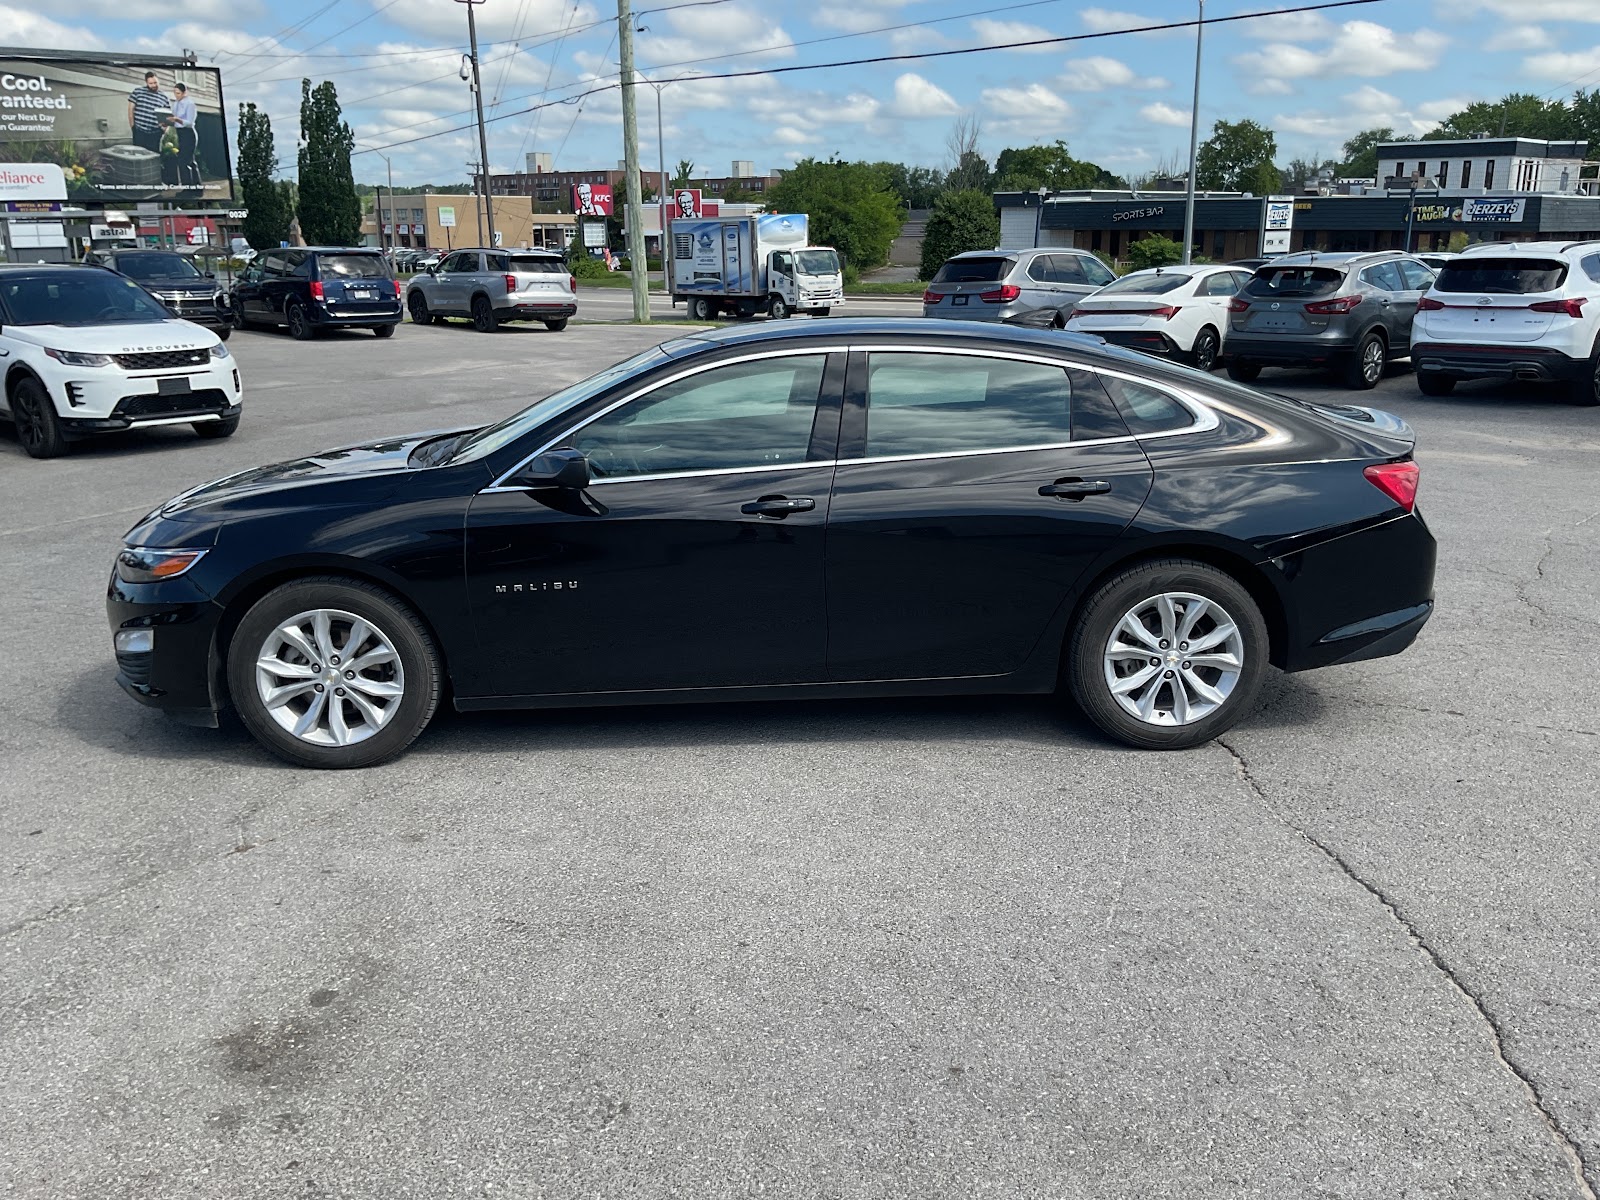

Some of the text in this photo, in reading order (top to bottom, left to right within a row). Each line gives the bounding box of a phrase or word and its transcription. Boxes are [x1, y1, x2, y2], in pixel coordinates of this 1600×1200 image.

[1, 74, 52, 91] Cool.
[0, 94, 72, 109] anteed.
[18, 113, 38, 121] Next
[39, 113, 55, 123] Day
[594, 194, 611, 202] KFC
[1112, 206, 1164, 222] SPORTS BAR
[1417, 205, 1435, 213] TIME
[1467, 202, 1519, 215] JERZEYS
[100, 228, 128, 236] astral
[122, 343, 196, 352] DISCOVERY
[495, 581, 578, 593] MALIBU
